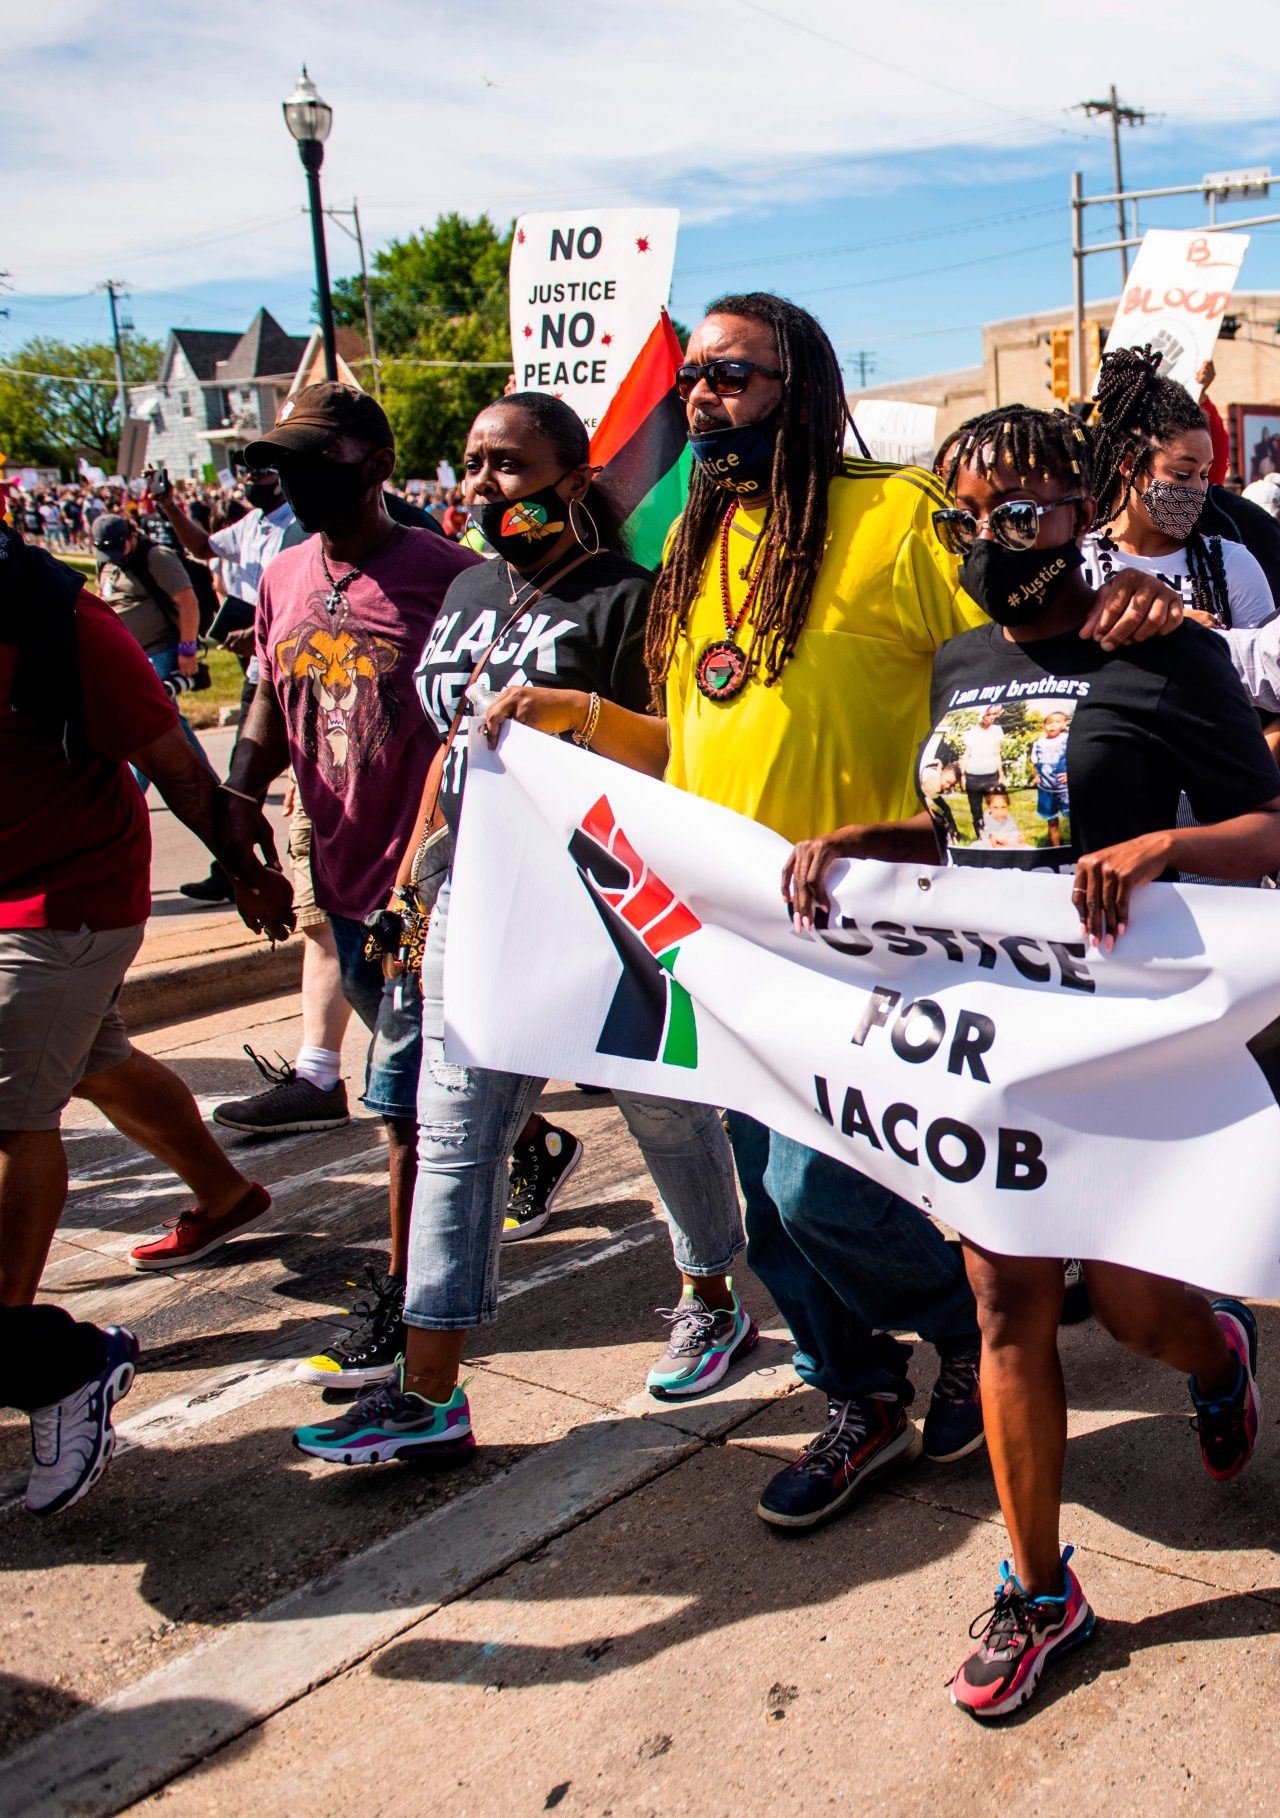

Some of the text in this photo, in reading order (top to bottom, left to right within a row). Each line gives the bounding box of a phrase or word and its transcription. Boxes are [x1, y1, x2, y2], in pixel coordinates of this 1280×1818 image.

[550, 227, 602, 261] NO
[529, 281, 616, 304] JUSTICE
[1124, 286, 1232, 319] BLOOD
[541, 312, 595, 349] NO
[524, 360, 607, 387] PEACE
[1008, 558, 1067, 607] #Justice
[413, 609, 580, 675] BLACK
[956, 689, 980, 705] am
[979, 685, 1006, 703] my
[1006, 675, 1091, 697] brothers
[850, 985, 997, 1085] FOR
[814, 1074, 1048, 1192] JACOB
